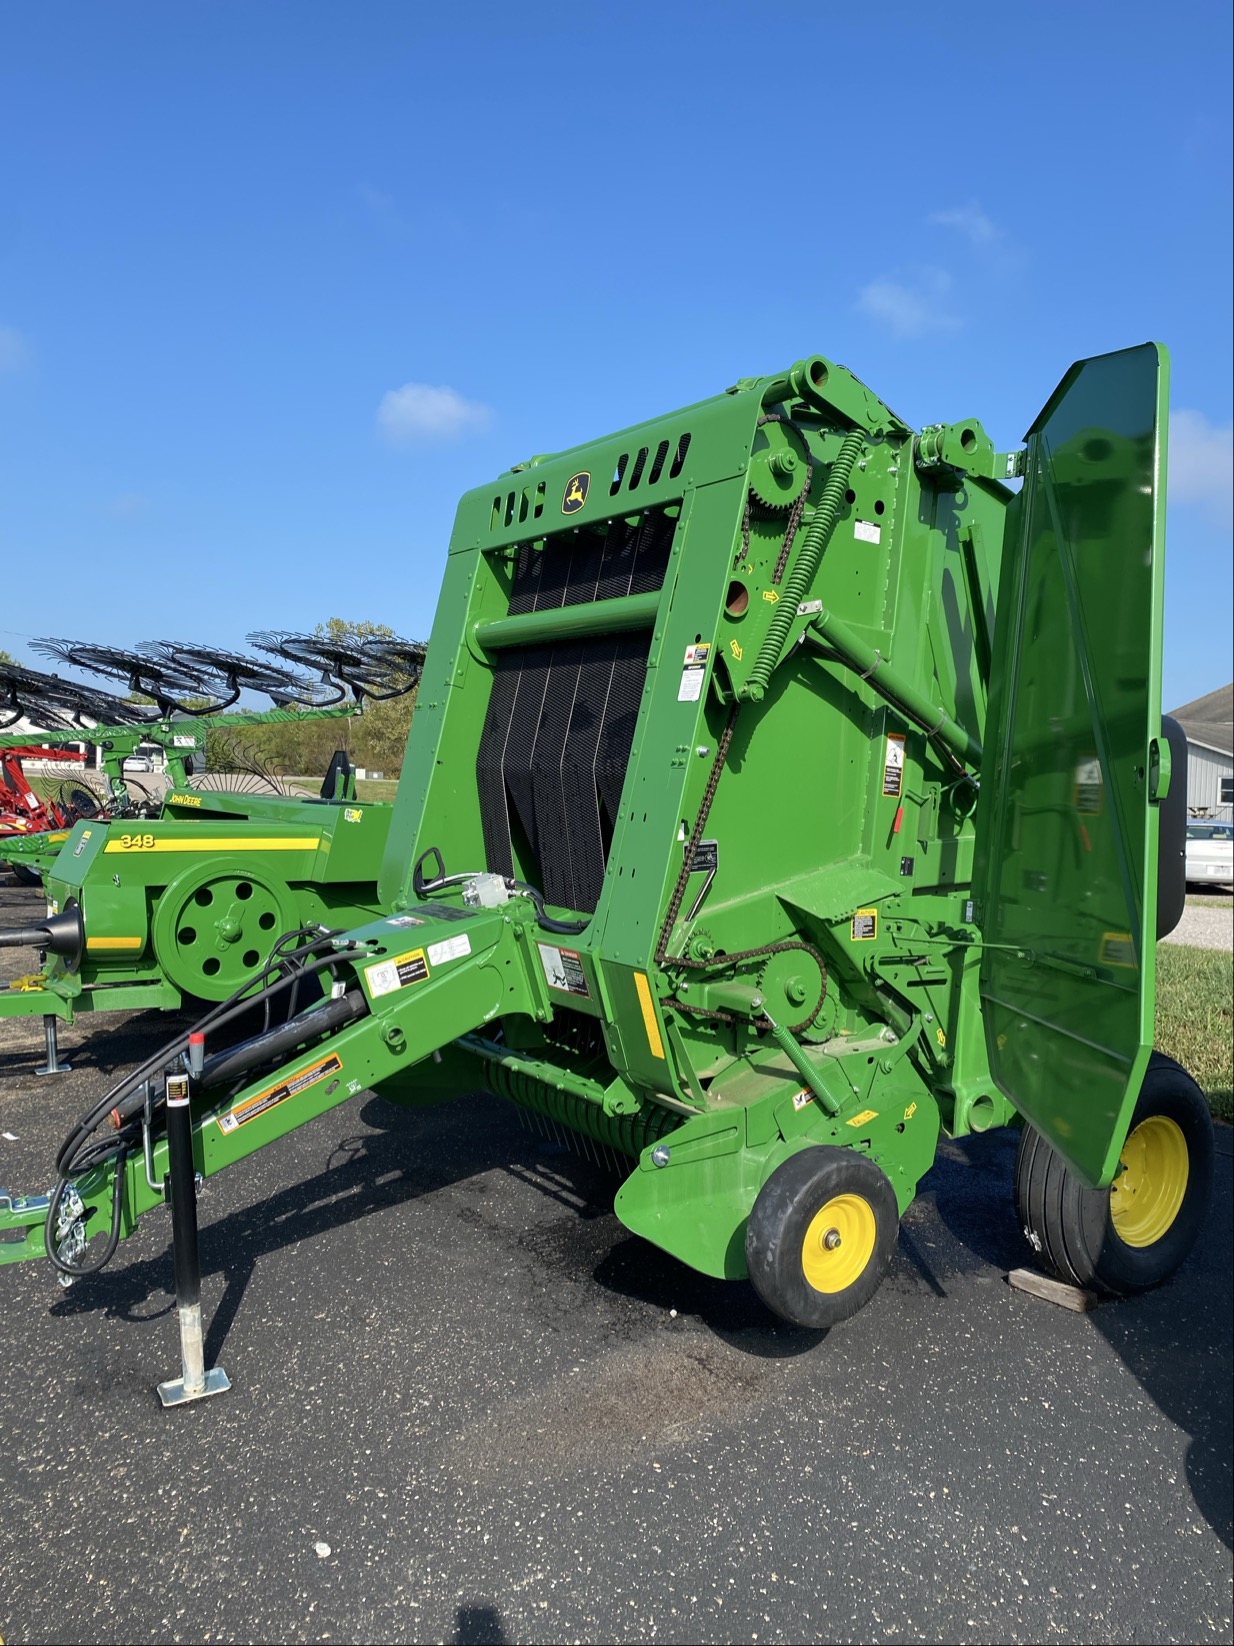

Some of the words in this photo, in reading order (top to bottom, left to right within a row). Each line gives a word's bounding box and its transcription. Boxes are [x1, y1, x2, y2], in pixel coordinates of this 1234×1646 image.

[170, 793, 184, 804] JOHN
[184, 795, 202, 807] DEERE
[120, 834, 155, 848] 348
[402, 952, 420, 962] CAUTION
